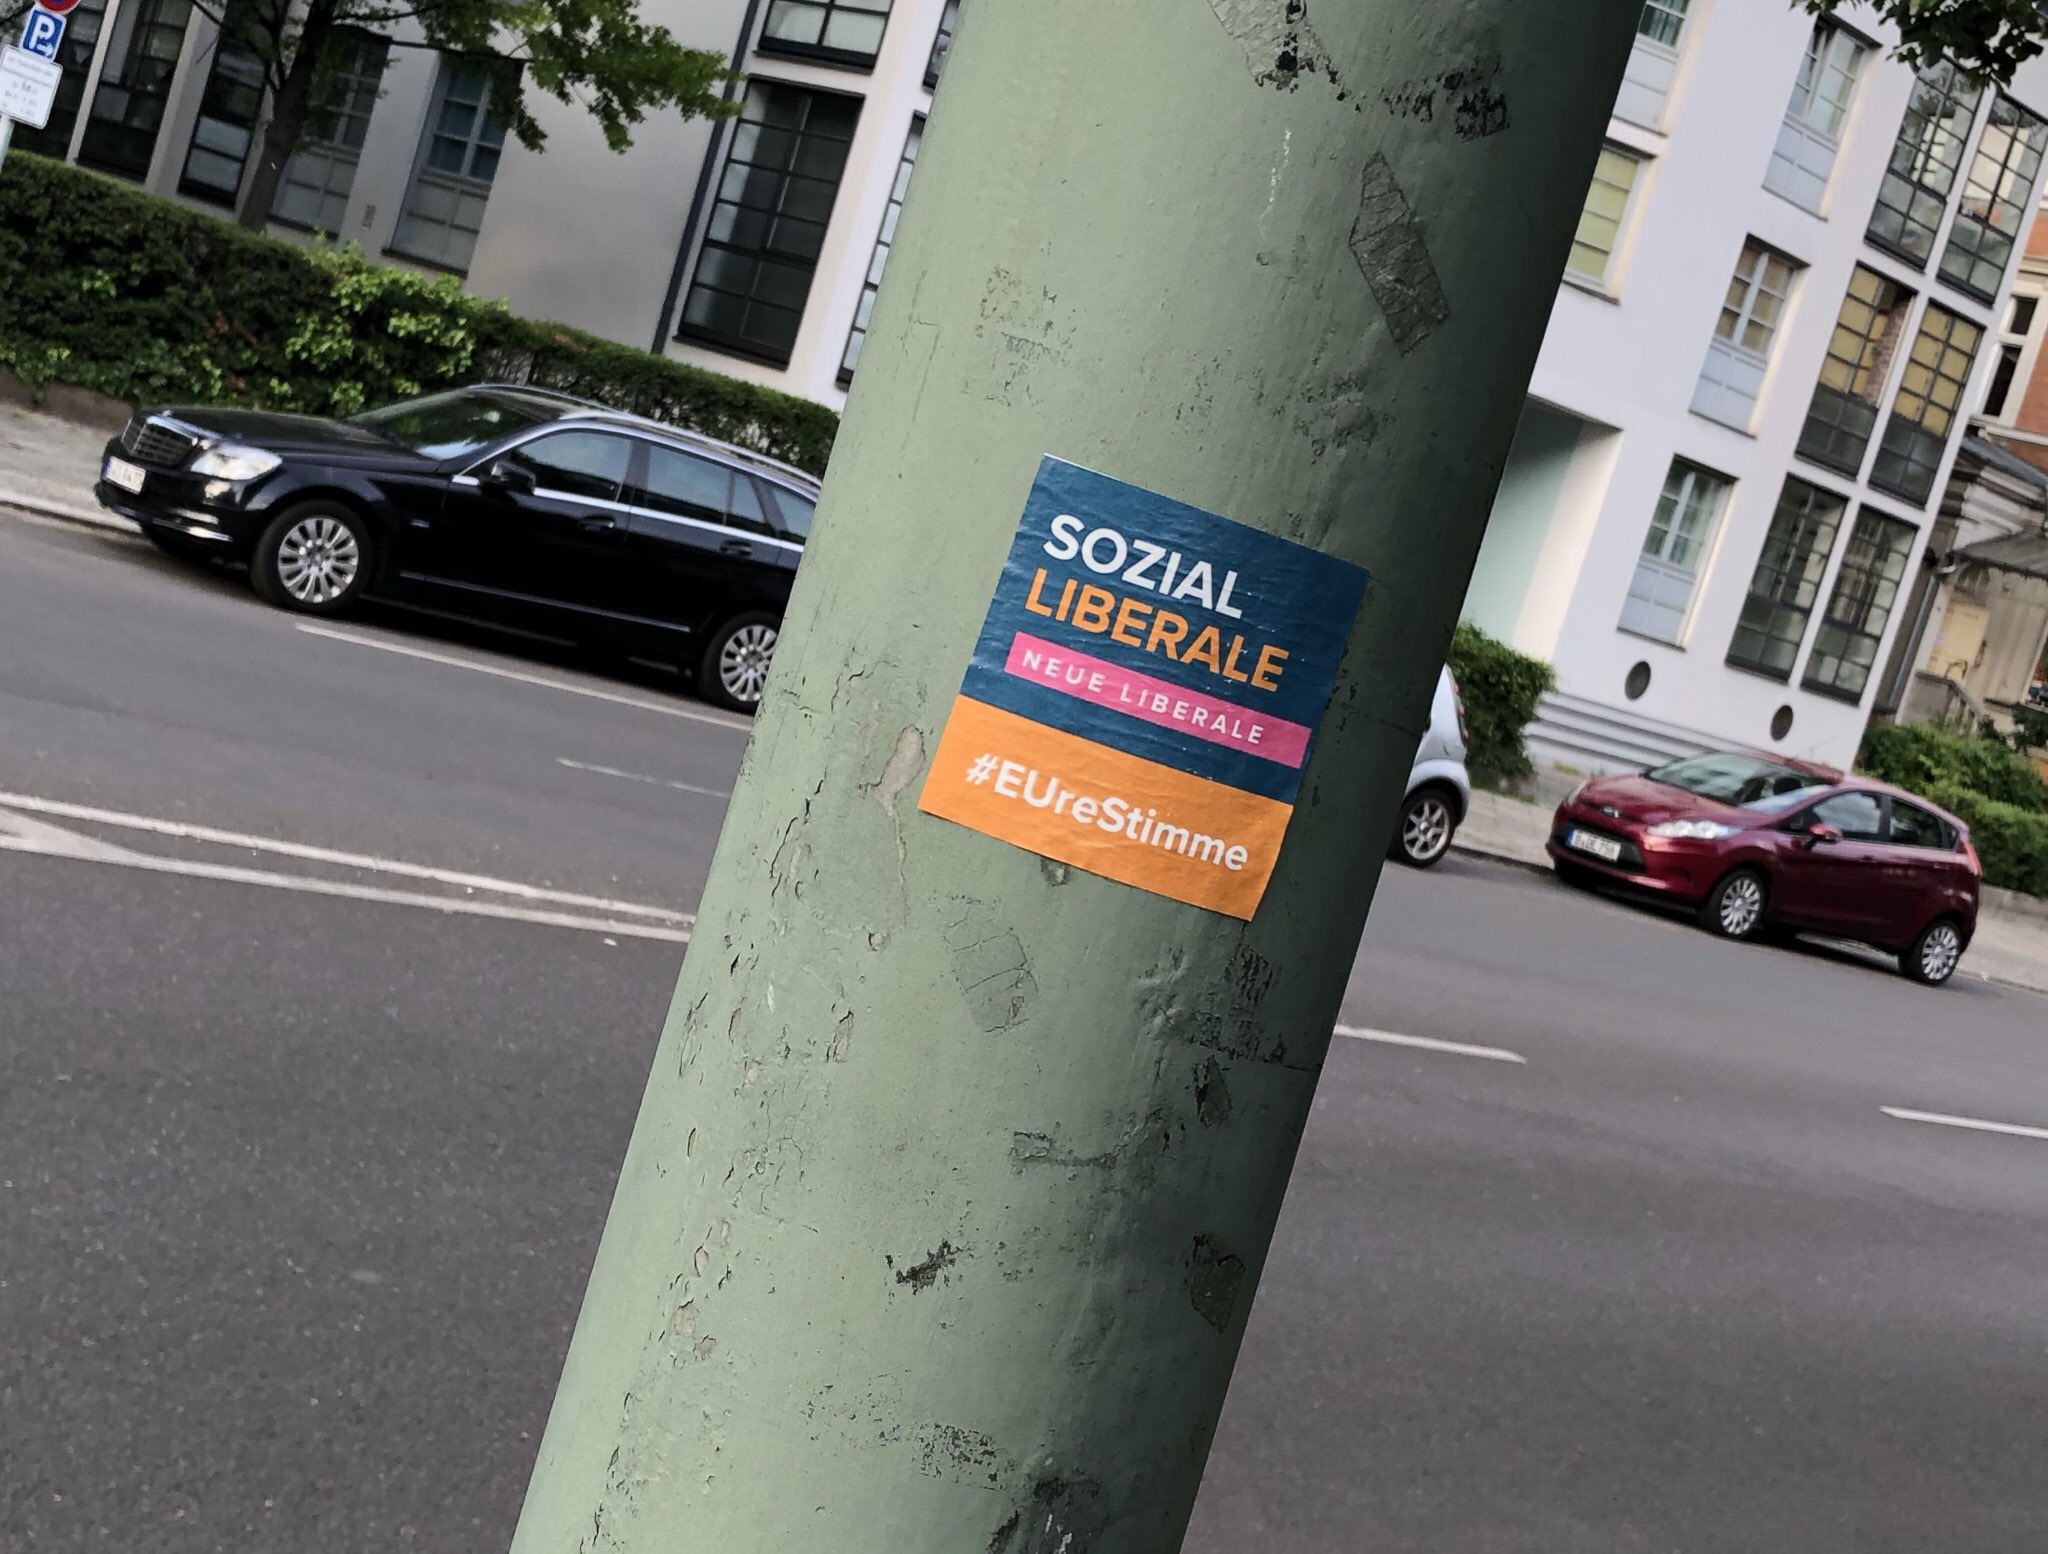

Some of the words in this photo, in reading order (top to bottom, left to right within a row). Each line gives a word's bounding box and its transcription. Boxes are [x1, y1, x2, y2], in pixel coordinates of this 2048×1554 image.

[29, 14, 55, 49] P
[1043, 514, 1243, 619] SOZIAL
[1024, 568, 1290, 692] LIBERALE
[1022, 649, 1106, 692] NEUE
[1119, 682, 1265, 744] LIBERALE
[965, 752, 1248, 871] #EUreStimme
